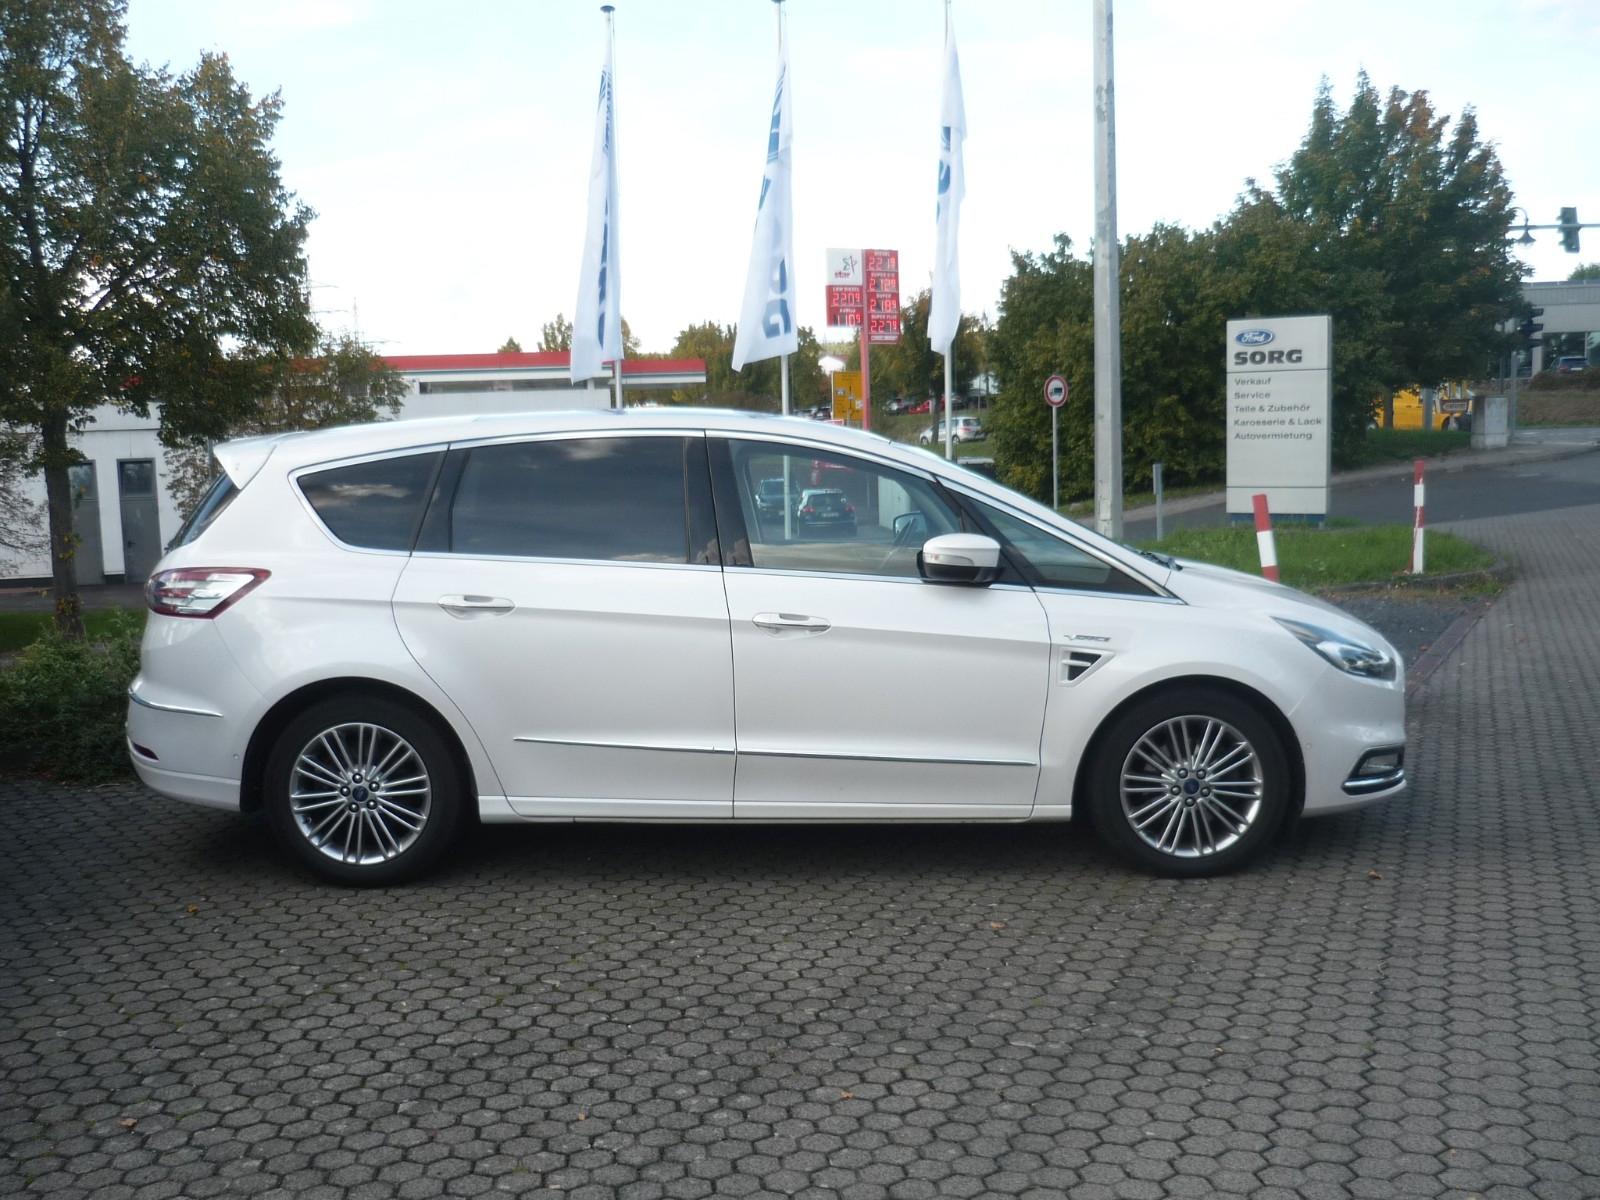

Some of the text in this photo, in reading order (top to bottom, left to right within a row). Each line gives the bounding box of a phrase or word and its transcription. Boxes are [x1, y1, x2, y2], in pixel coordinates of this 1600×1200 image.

[1241, 331, 1266, 343] Ford
[1234, 349, 1303, 366] SORG
[1234, 376, 1271, 386] Verkauf
[1234, 391, 1271, 400] Service
[1234, 405, 1256, 413] Teile
[1268, 403, 1311, 413] Zubehör
[1234, 417, 1322, 427] Karosserie & Lack
[1234, 432, 1313, 441] Autovermietung
